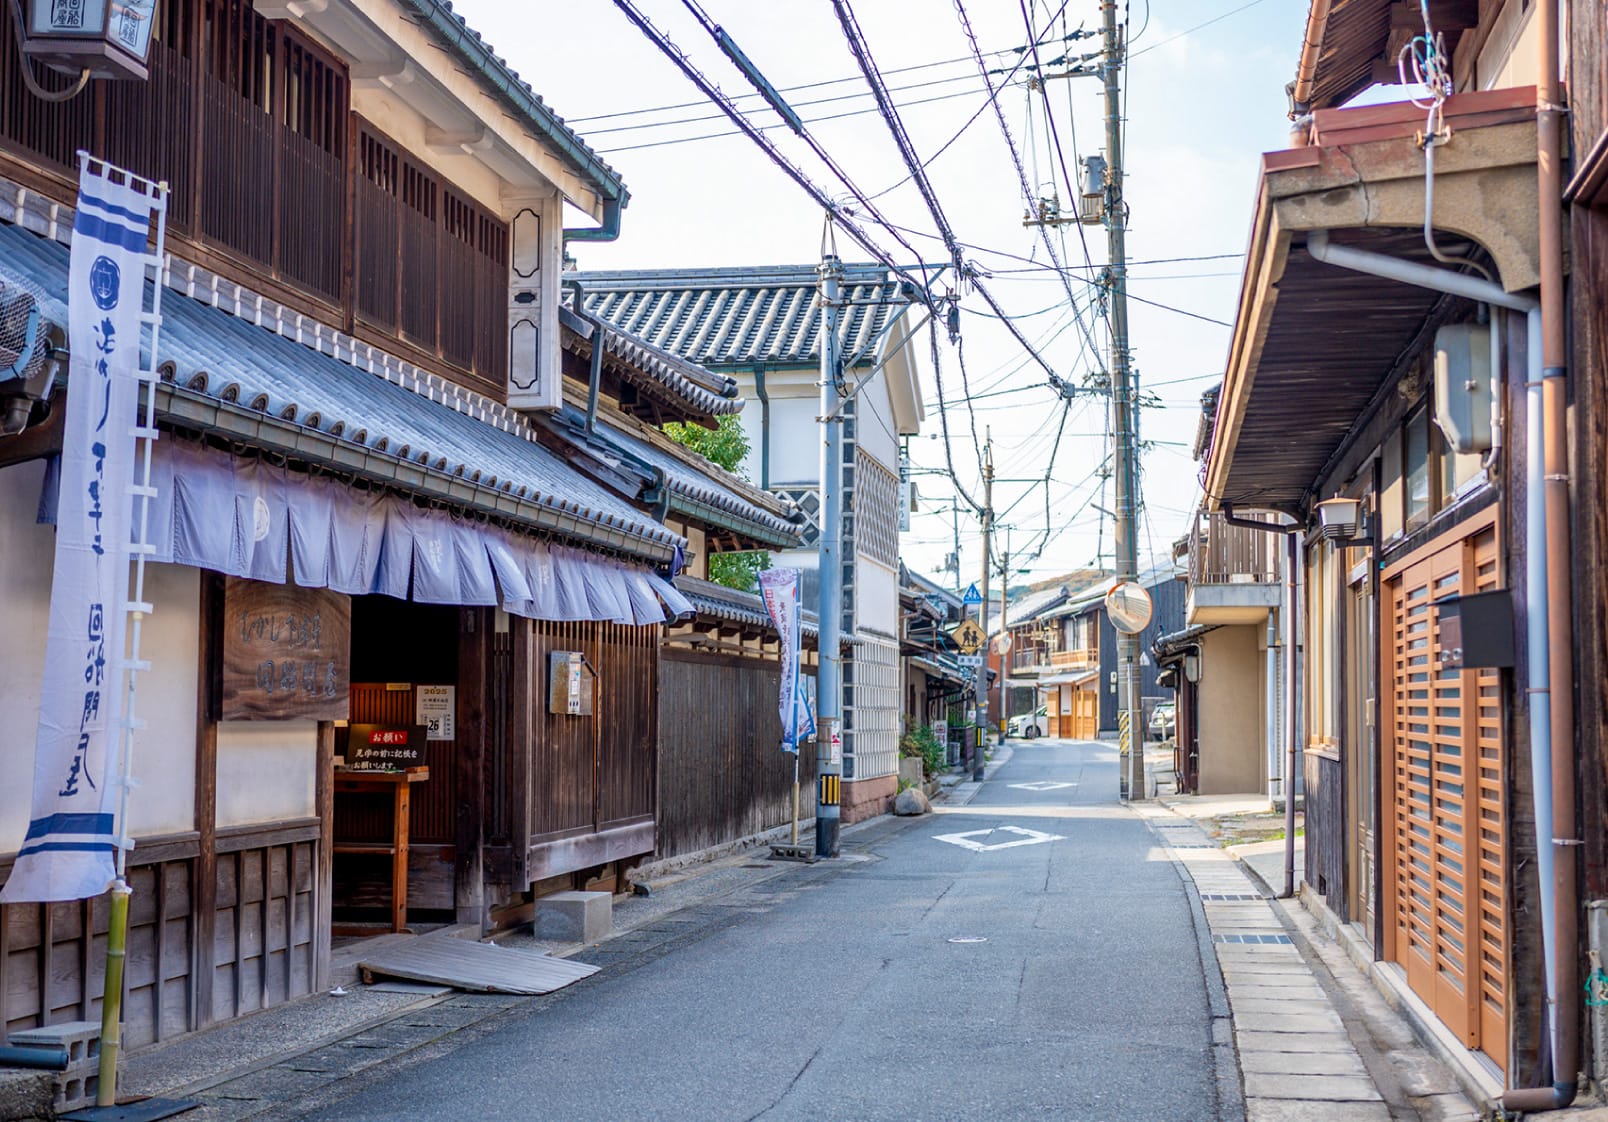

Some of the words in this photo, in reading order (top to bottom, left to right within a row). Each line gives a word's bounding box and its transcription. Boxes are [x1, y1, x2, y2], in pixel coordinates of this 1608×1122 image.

[428, 719, 440, 731] 26
[373, 731, 404, 743] お願い
[353, 761, 397, 769] お願いします。
